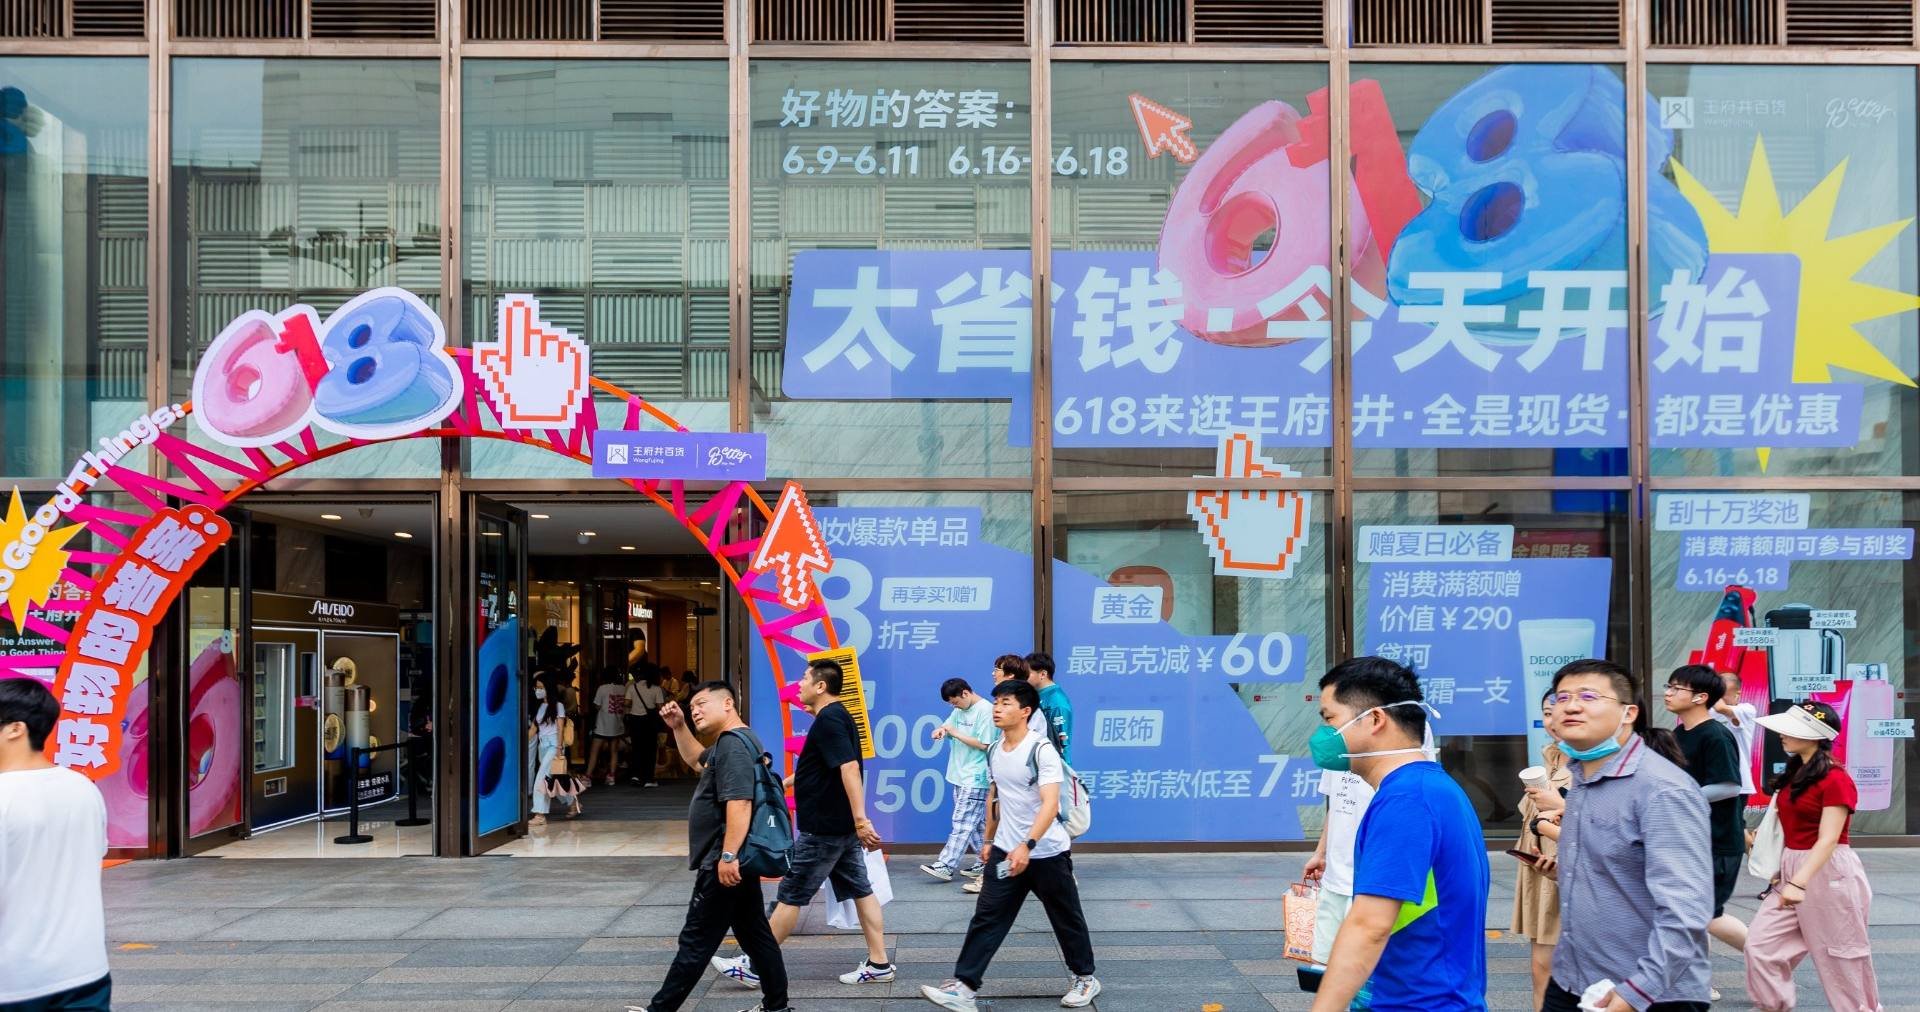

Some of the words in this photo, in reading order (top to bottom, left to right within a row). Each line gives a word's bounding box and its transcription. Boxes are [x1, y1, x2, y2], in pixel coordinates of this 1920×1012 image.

[780, 88, 1014, 129] 好物的答案:
[1703, 100, 1786, 115] 王府井百货
[781, 145, 919, 175] 6.9-6.11
[202, 296, 455, 437] 618
[633, 446, 685, 457] 王府井百货
[3, 481, 84, 570] Good
[65, 403, 186, 488] Things:
[1668, 500, 1800, 525] 刮十万奖池
[1369, 530, 1503, 557] 赠夏日必备
[1684, 535, 1907, 557] 消费满额即可参与刮奖
[1382, 569, 1522, 598] 消费满额赠
[1683, 568, 1779, 585] 6.16-6.18
[891, 585, 978, 604] 再享买1赠1
[1100, 593, 1154, 619] 黄金
[308, 600, 354, 617] SHISEIDO
[1380, 604, 1513, 633] 价值¥290
[17, 637, 56, 646] Answer
[54, 511, 219, 769] 好物的答案:
[877, 620, 941, 650] 折享
[9, 648, 36, 657] Good
[1100, 716, 1155, 743] 服饰
